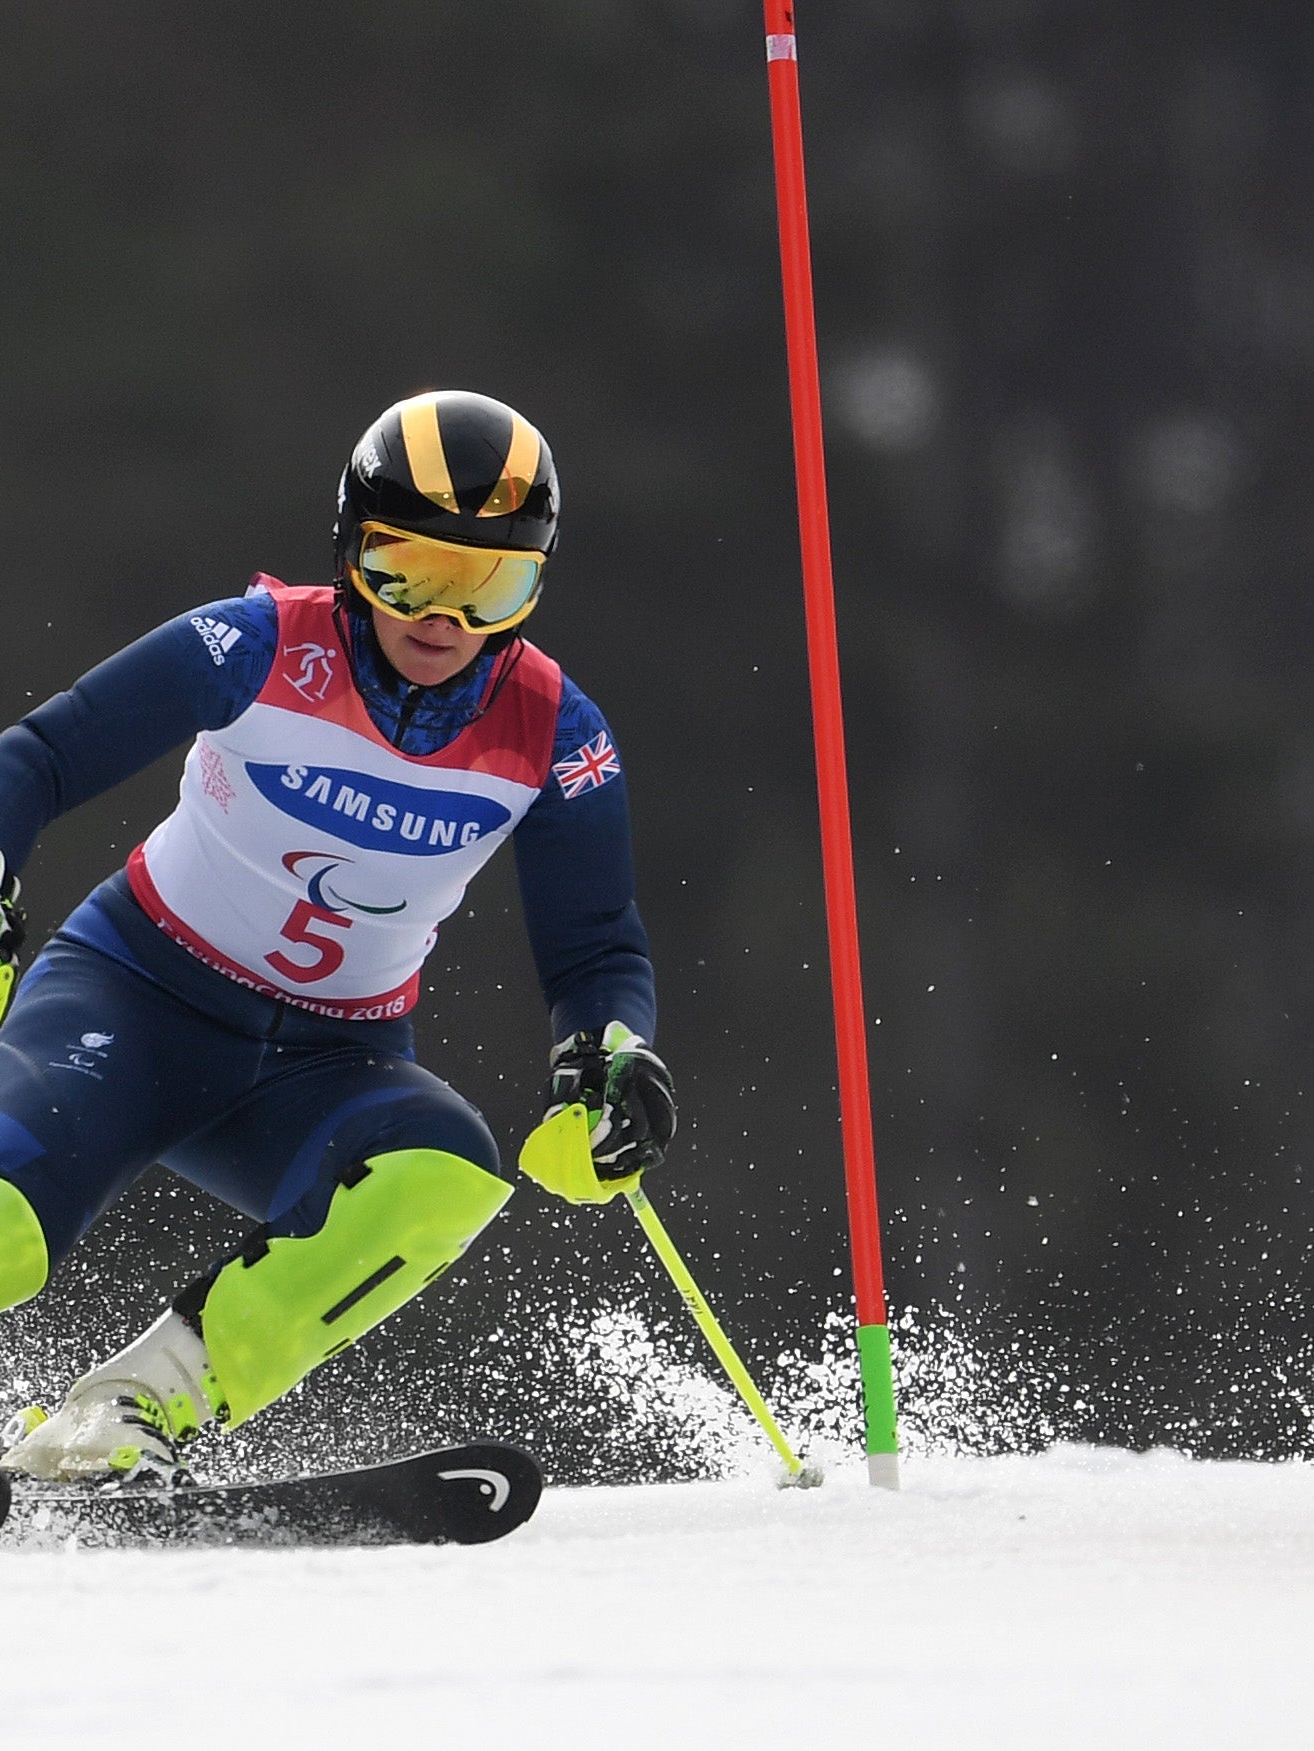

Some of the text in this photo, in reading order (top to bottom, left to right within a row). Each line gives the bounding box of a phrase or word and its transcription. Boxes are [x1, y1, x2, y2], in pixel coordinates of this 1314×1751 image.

[190, 617, 225, 666] adidas
[280, 764, 481, 847] SAMSUNG
[263, 898, 354, 985] 5
[348, 995, 406, 1020] 2018
